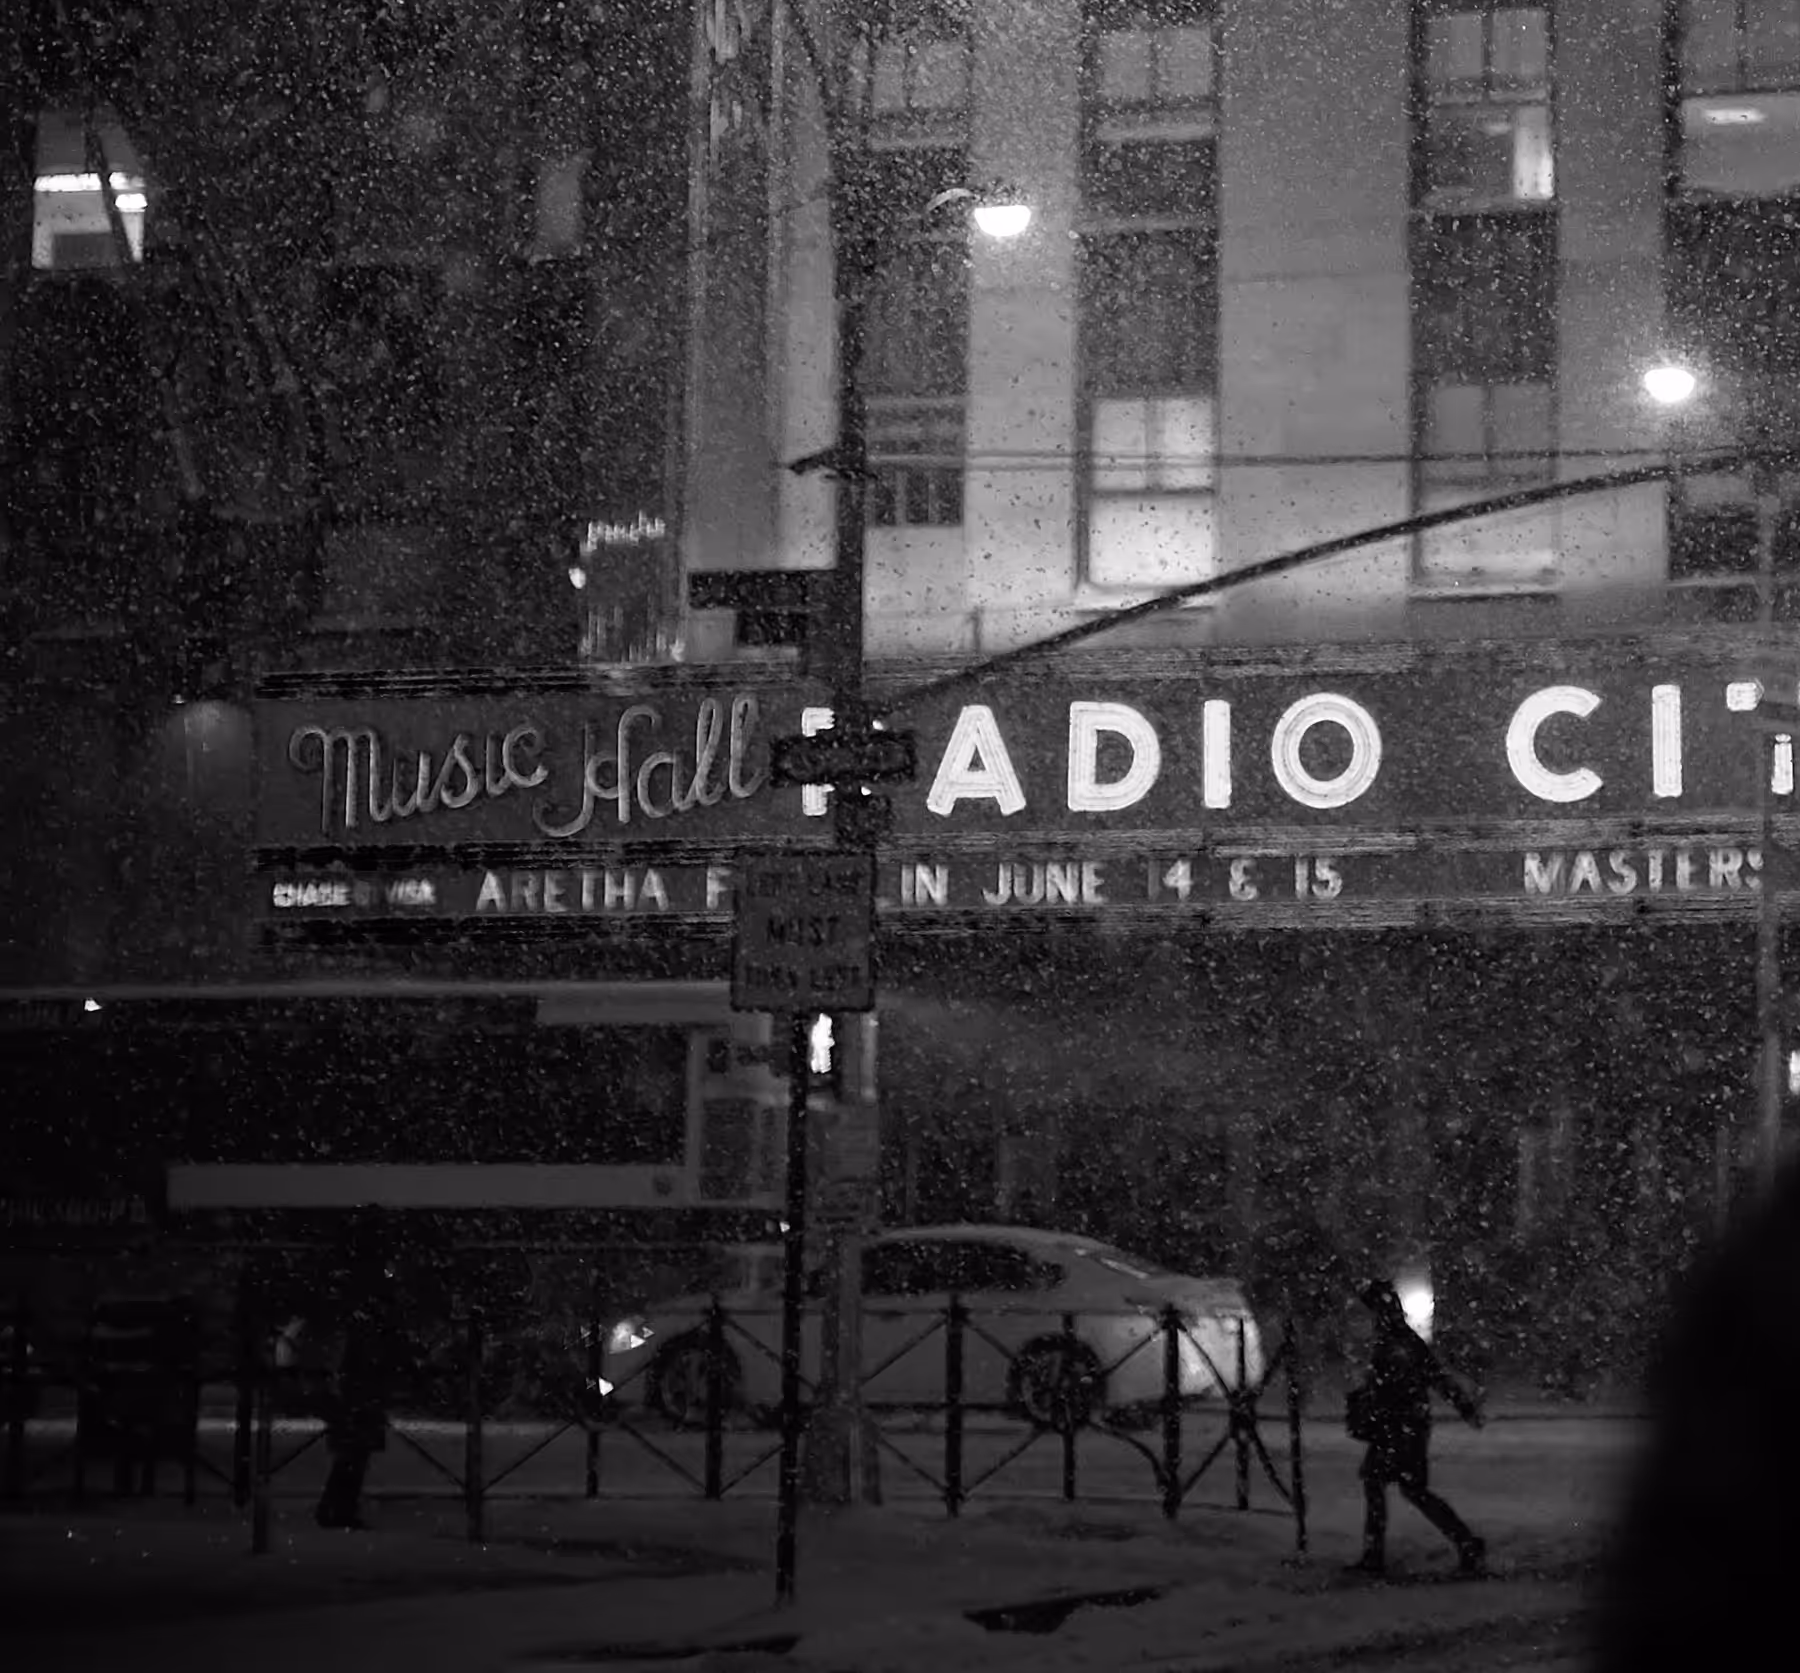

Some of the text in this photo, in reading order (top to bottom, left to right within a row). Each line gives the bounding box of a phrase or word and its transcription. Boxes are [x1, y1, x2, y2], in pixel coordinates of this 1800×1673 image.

[287, 696, 773, 838] Music Hall
[475, 867, 671, 912] ARETHA
[901, 863, 949, 907] IN
[982, 861, 1104, 907] JUNE
[1148, 858, 1194, 902] 14
[1295, 857, 1343, 901] 15
